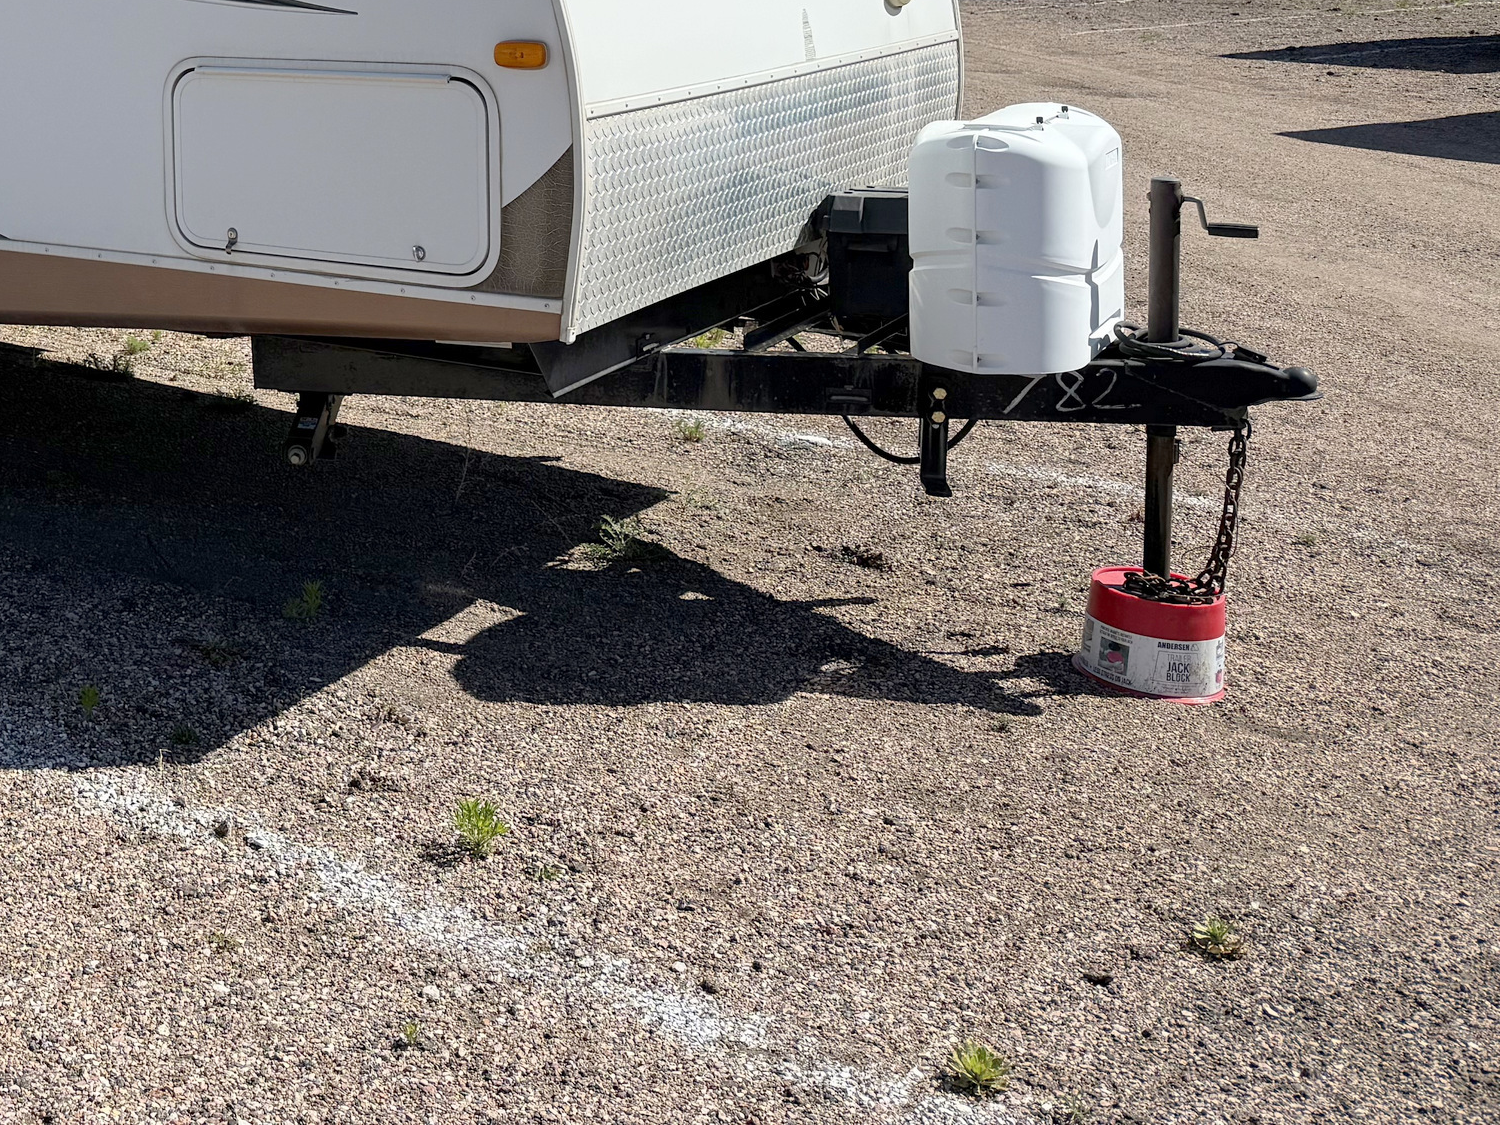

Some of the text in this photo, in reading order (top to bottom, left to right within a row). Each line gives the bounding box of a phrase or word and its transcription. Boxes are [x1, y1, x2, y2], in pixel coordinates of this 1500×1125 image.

[1002, 367, 1142, 414] 782
[1157, 641, 1190, 651] ANDERSEN
[1167, 653, 1192, 662] TRAILER
[1167, 662, 1190, 674] JACK
[1166, 672, 1191, 682] BLOCK
